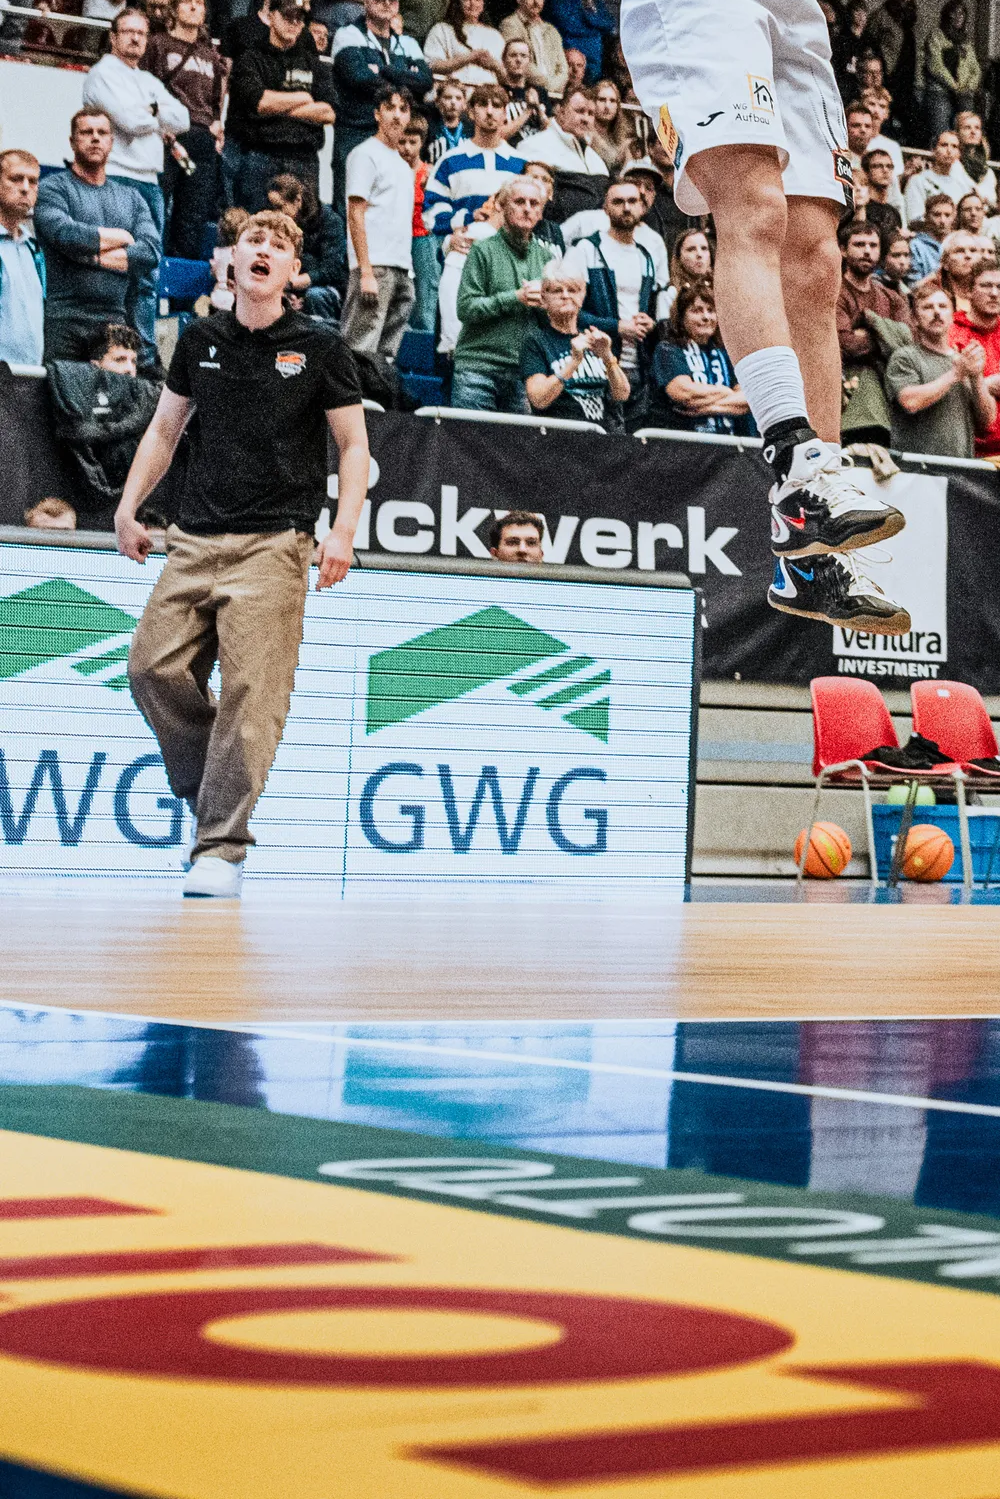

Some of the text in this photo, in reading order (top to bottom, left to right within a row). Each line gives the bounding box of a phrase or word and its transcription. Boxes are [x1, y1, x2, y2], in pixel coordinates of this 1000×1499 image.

[735, 112, 770, 125] Aufbau
[838, 658, 940, 678] INVESTMENT
[0, 749, 185, 848] WG
[359, 761, 609, 855] GWG
